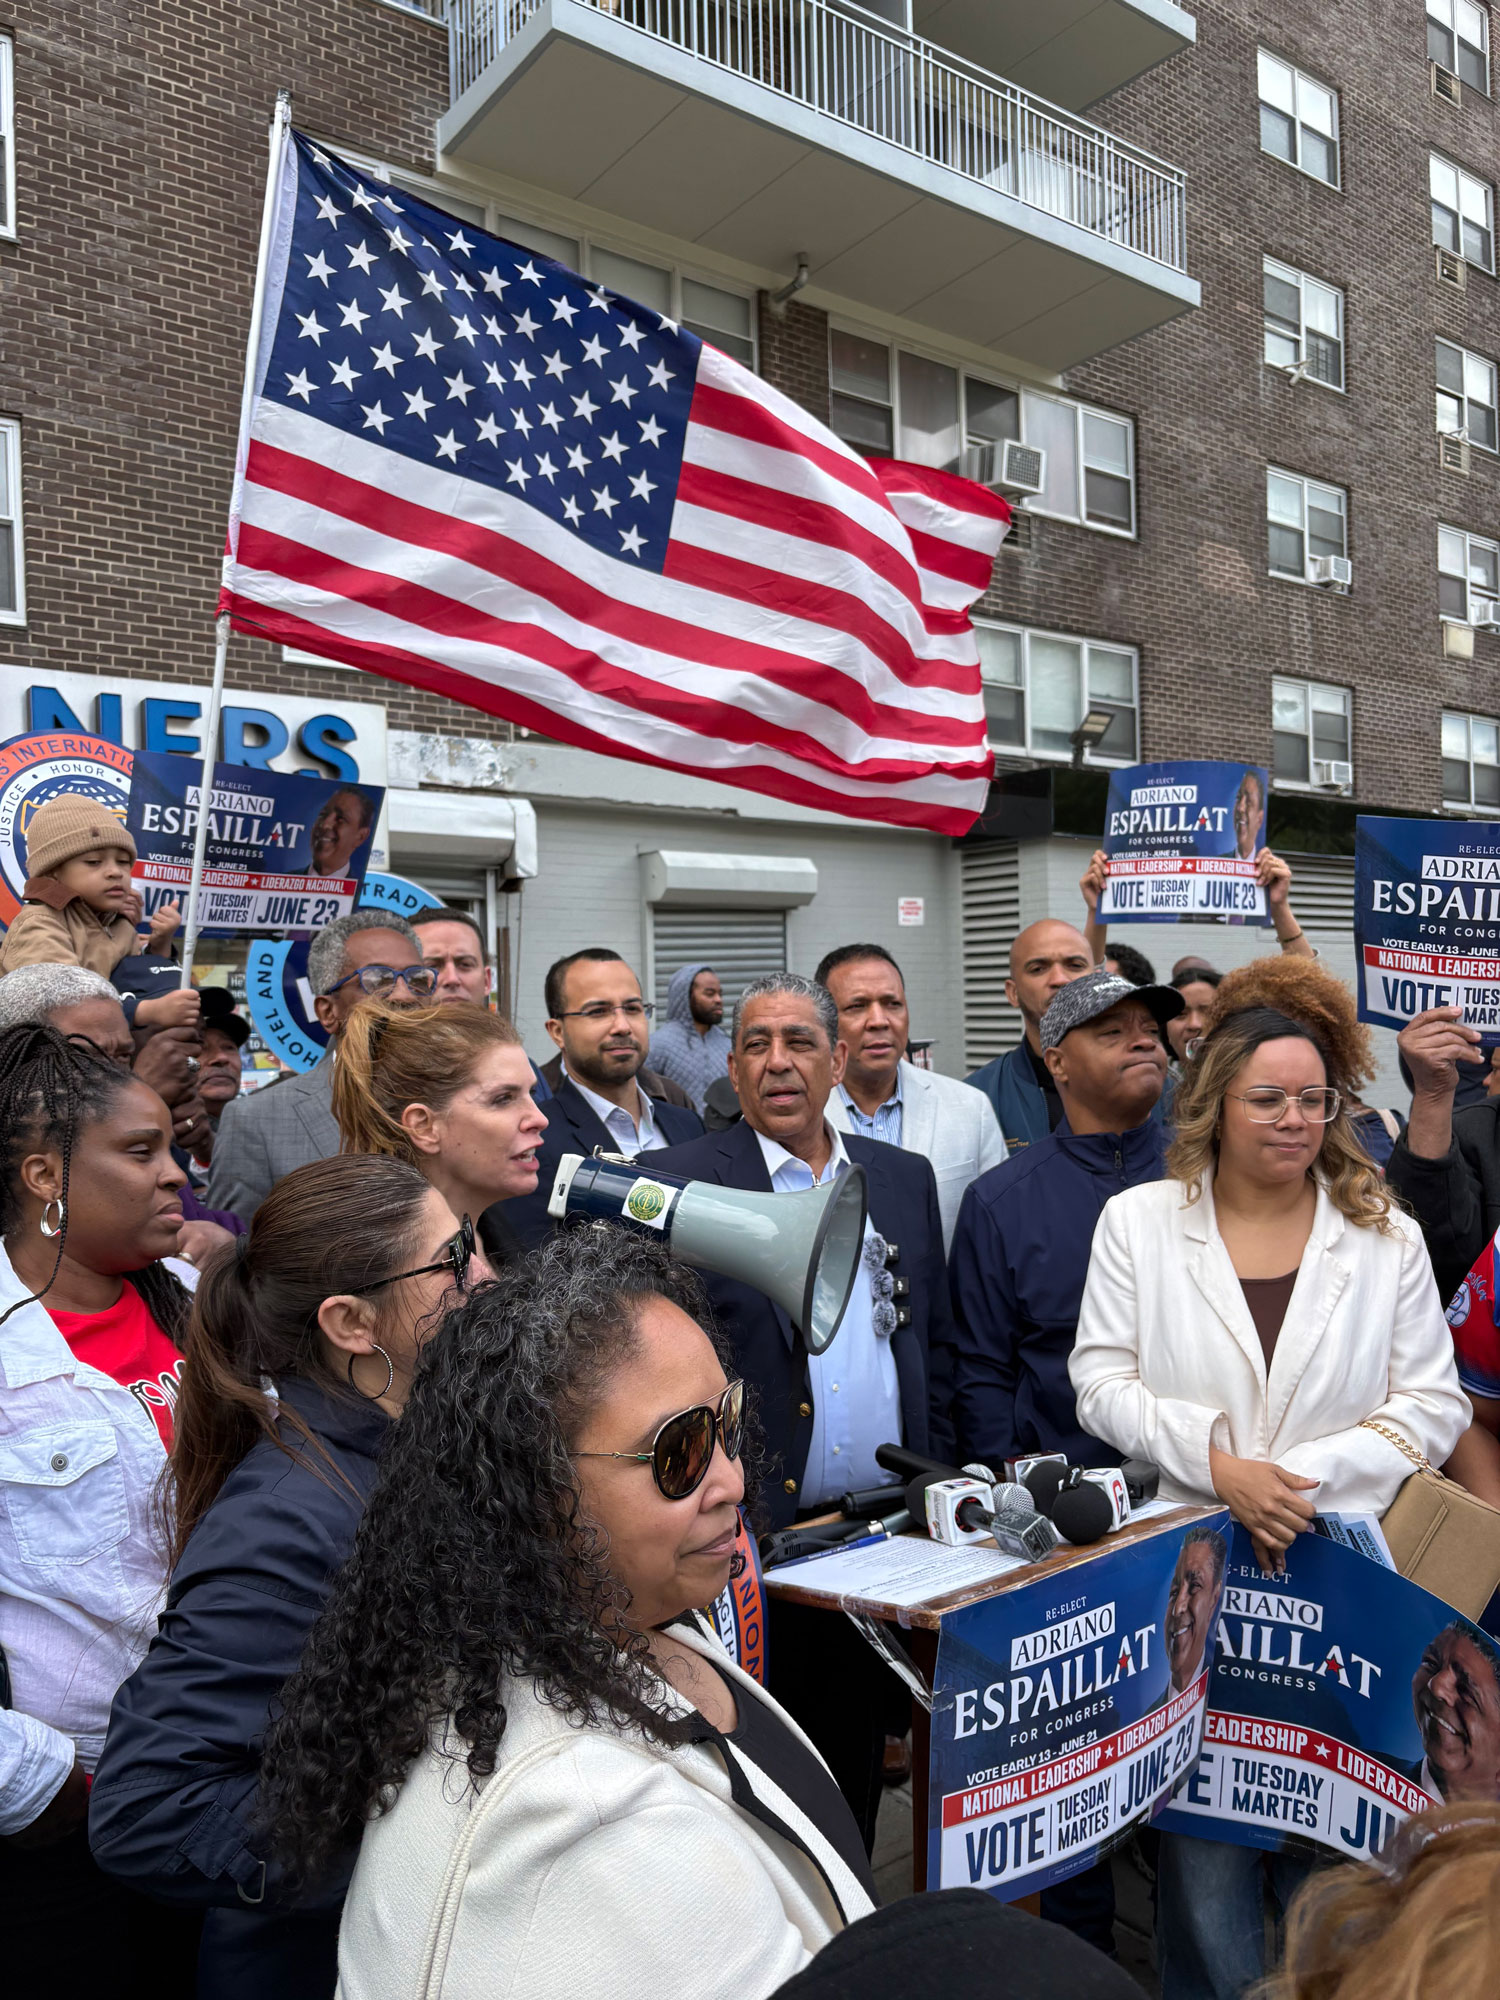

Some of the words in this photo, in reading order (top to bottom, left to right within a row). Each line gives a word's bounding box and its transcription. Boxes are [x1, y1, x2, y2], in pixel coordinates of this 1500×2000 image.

[50, 763, 105, 778] HONOR
[1147, 777, 1175, 786] RE-ELECT
[215, 780, 252, 792] RE-ELECT
[1132, 787, 1195, 805] ADRIANO
[0, 784, 26, 847] JUSTICE
[142, 803, 305, 849] ESPAILLAT
[1110, 806, 1228, 836] ESPAILLAT
[181, 841, 196, 850] FO
[208, 845, 264, 859] CONGRESS
[1128, 838, 1142, 846] FOR
[1145, 835, 1194, 845] CONGRESS
[148, 852, 174, 863] VOTE
[174, 855, 195, 866] EARL
[215, 861, 238, 870] JUNE
[1137, 860, 1183, 874] LEADERSHIP
[1195, 860, 1235, 874] LIDERAZGO
[144, 863, 191, 882] NATIONAL
[200, 870, 249, 888] EADERSHIP
[260, 876, 305, 891] LIDERAZGO
[305, 878, 345, 893] NACIONAL
[1151, 879, 1190, 893] TUESDAY
[145, 886, 202, 918] VOT
[210, 892, 253, 909] TUESDAY
[361, 882, 428, 910] TRAD
[1111, 880, 1145, 909] VOTE
[1150, 894, 1189, 908] MARTES
[1199, 880, 1240, 909] JUNE
[1241, 883, 1257, 910] 23
[207, 908, 249, 923] MARTES
[257, 896, 311, 925] JUNE
[311, 898, 340, 926] 23
[1419, 923, 1446, 935] FOR
[1454, 927, 1500, 939] CONG
[1378, 950, 1435, 974] NATIONAL
[1382, 937, 1410, 949] VOTE
[1411, 941, 1444, 953] EARLY
[1446, 945, 1459, 955] 13
[1467, 947, 1499, 957] JUNE
[257, 953, 274, 999] AND
[265, 1008, 319, 1067] HOTEL
[1227, 1563, 1293, 1585] -ELCT
[1045, 1596, 1087, 1622] RE-ELECT
[1225, 1589, 1319, 1626] RIANO
[739, 1574, 760, 1683] NION
[1014, 1607, 1113, 1666] ADRIANO
[1216, 1617, 1382, 1700] AILLAT
[953, 1623, 1156, 1740] ESPAILLAT
[1218, 1664, 1317, 1692] CONGRESS
[1010, 1728, 1038, 1748] FOR
[1045, 1696, 1114, 1735] CONGRESS
[962, 1777, 1028, 1818] NATIONAL
[1031, 1745, 1102, 1795] LEADERSHIP
[1117, 1711, 1166, 1757] LIDERAZGO
[1167, 1686, 1200, 1725] NACIONAL
[966, 1767, 1000, 1786] VOTE
[1000, 1755, 1037, 1777] EARLY
[1038, 1751, 1051, 1764] 13
[1057, 1738, 1085, 1759] JUNE
[1086, 1729, 1098, 1743] 21
[1120, 1735, 1173, 1817] JUNE
[1172, 1714, 1196, 1775] 23
[1205, 1714, 1308, 1754] EADERSHIP
[1337, 1746, 1428, 1815] LIDERAZGO
[1231, 1757, 1325, 1800] TUESDAY
[1057, 1777, 1112, 1824] TUESDAY
[1231, 1786, 1318, 1829] MARTES
[1057, 1808, 1109, 1852] MARTES
[1340, 1795, 1397, 1857] JU
[965, 1806, 1046, 1884] VOTE
